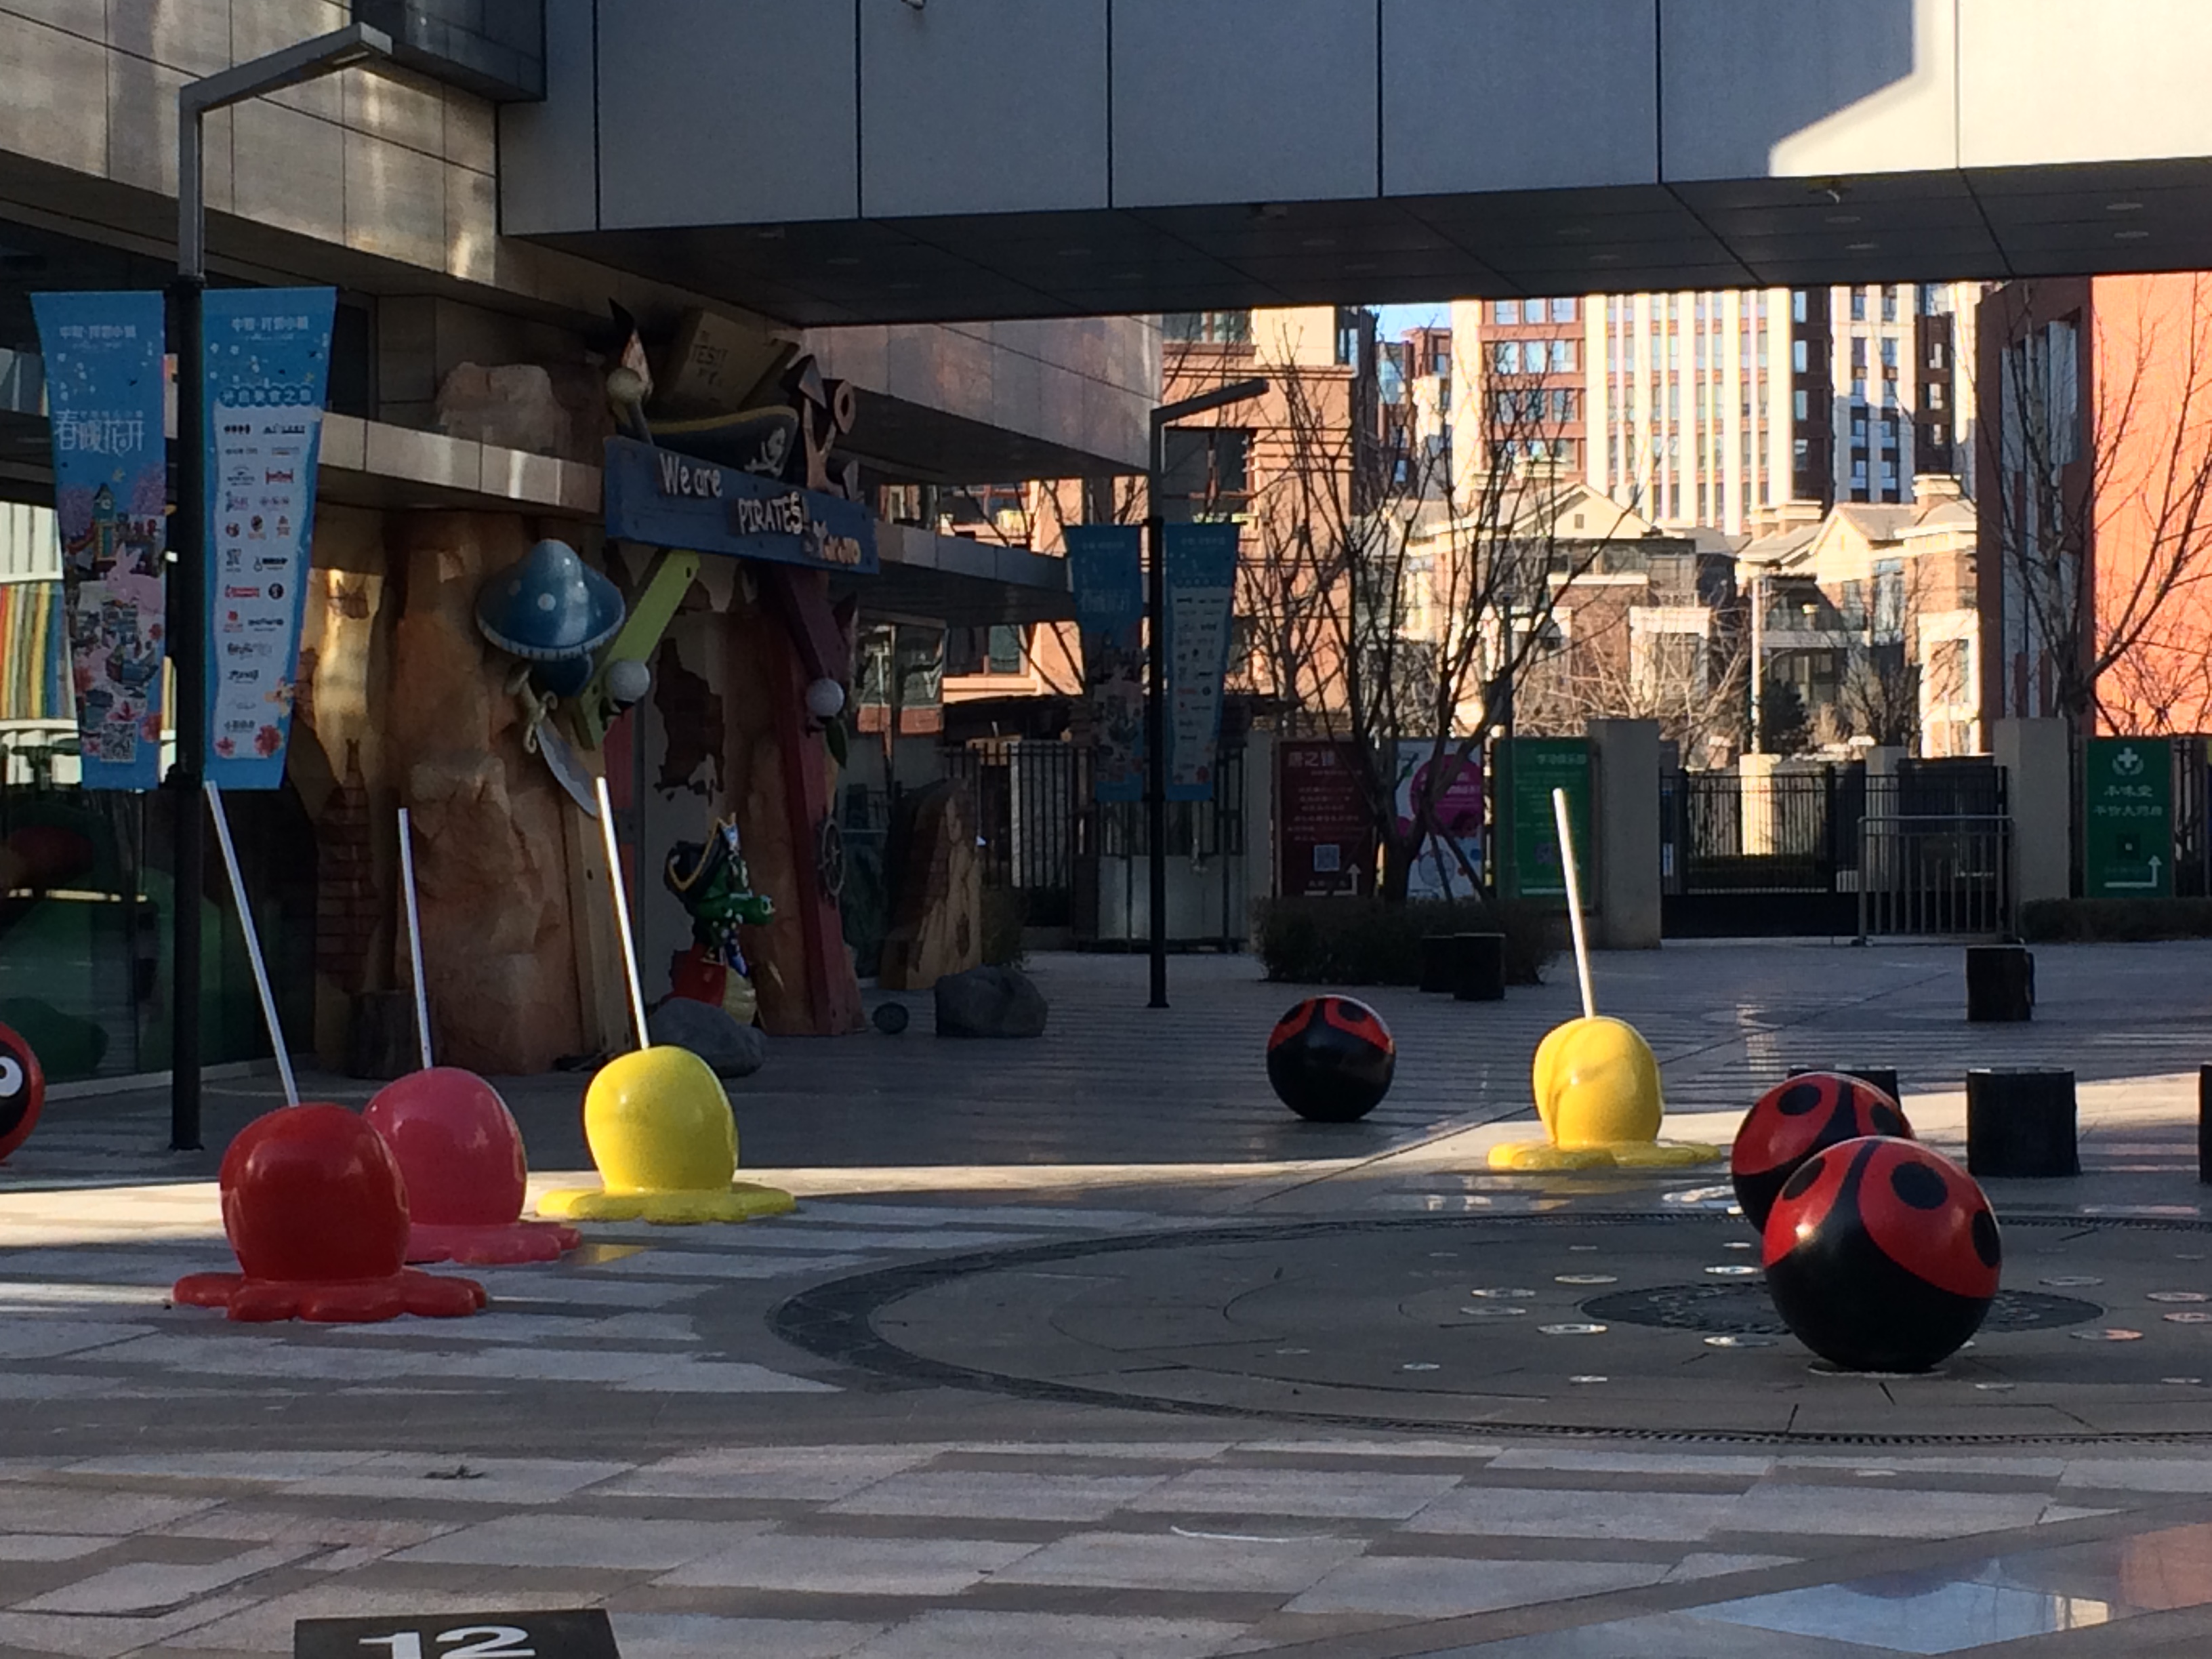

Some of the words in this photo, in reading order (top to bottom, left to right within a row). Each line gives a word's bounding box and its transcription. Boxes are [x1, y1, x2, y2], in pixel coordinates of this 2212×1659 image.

[54, 408, 145, 457] 春暖花开
[659, 452, 691, 495] We
[694, 468, 724, 498] are
[359, 1625, 537, 1659] 12
